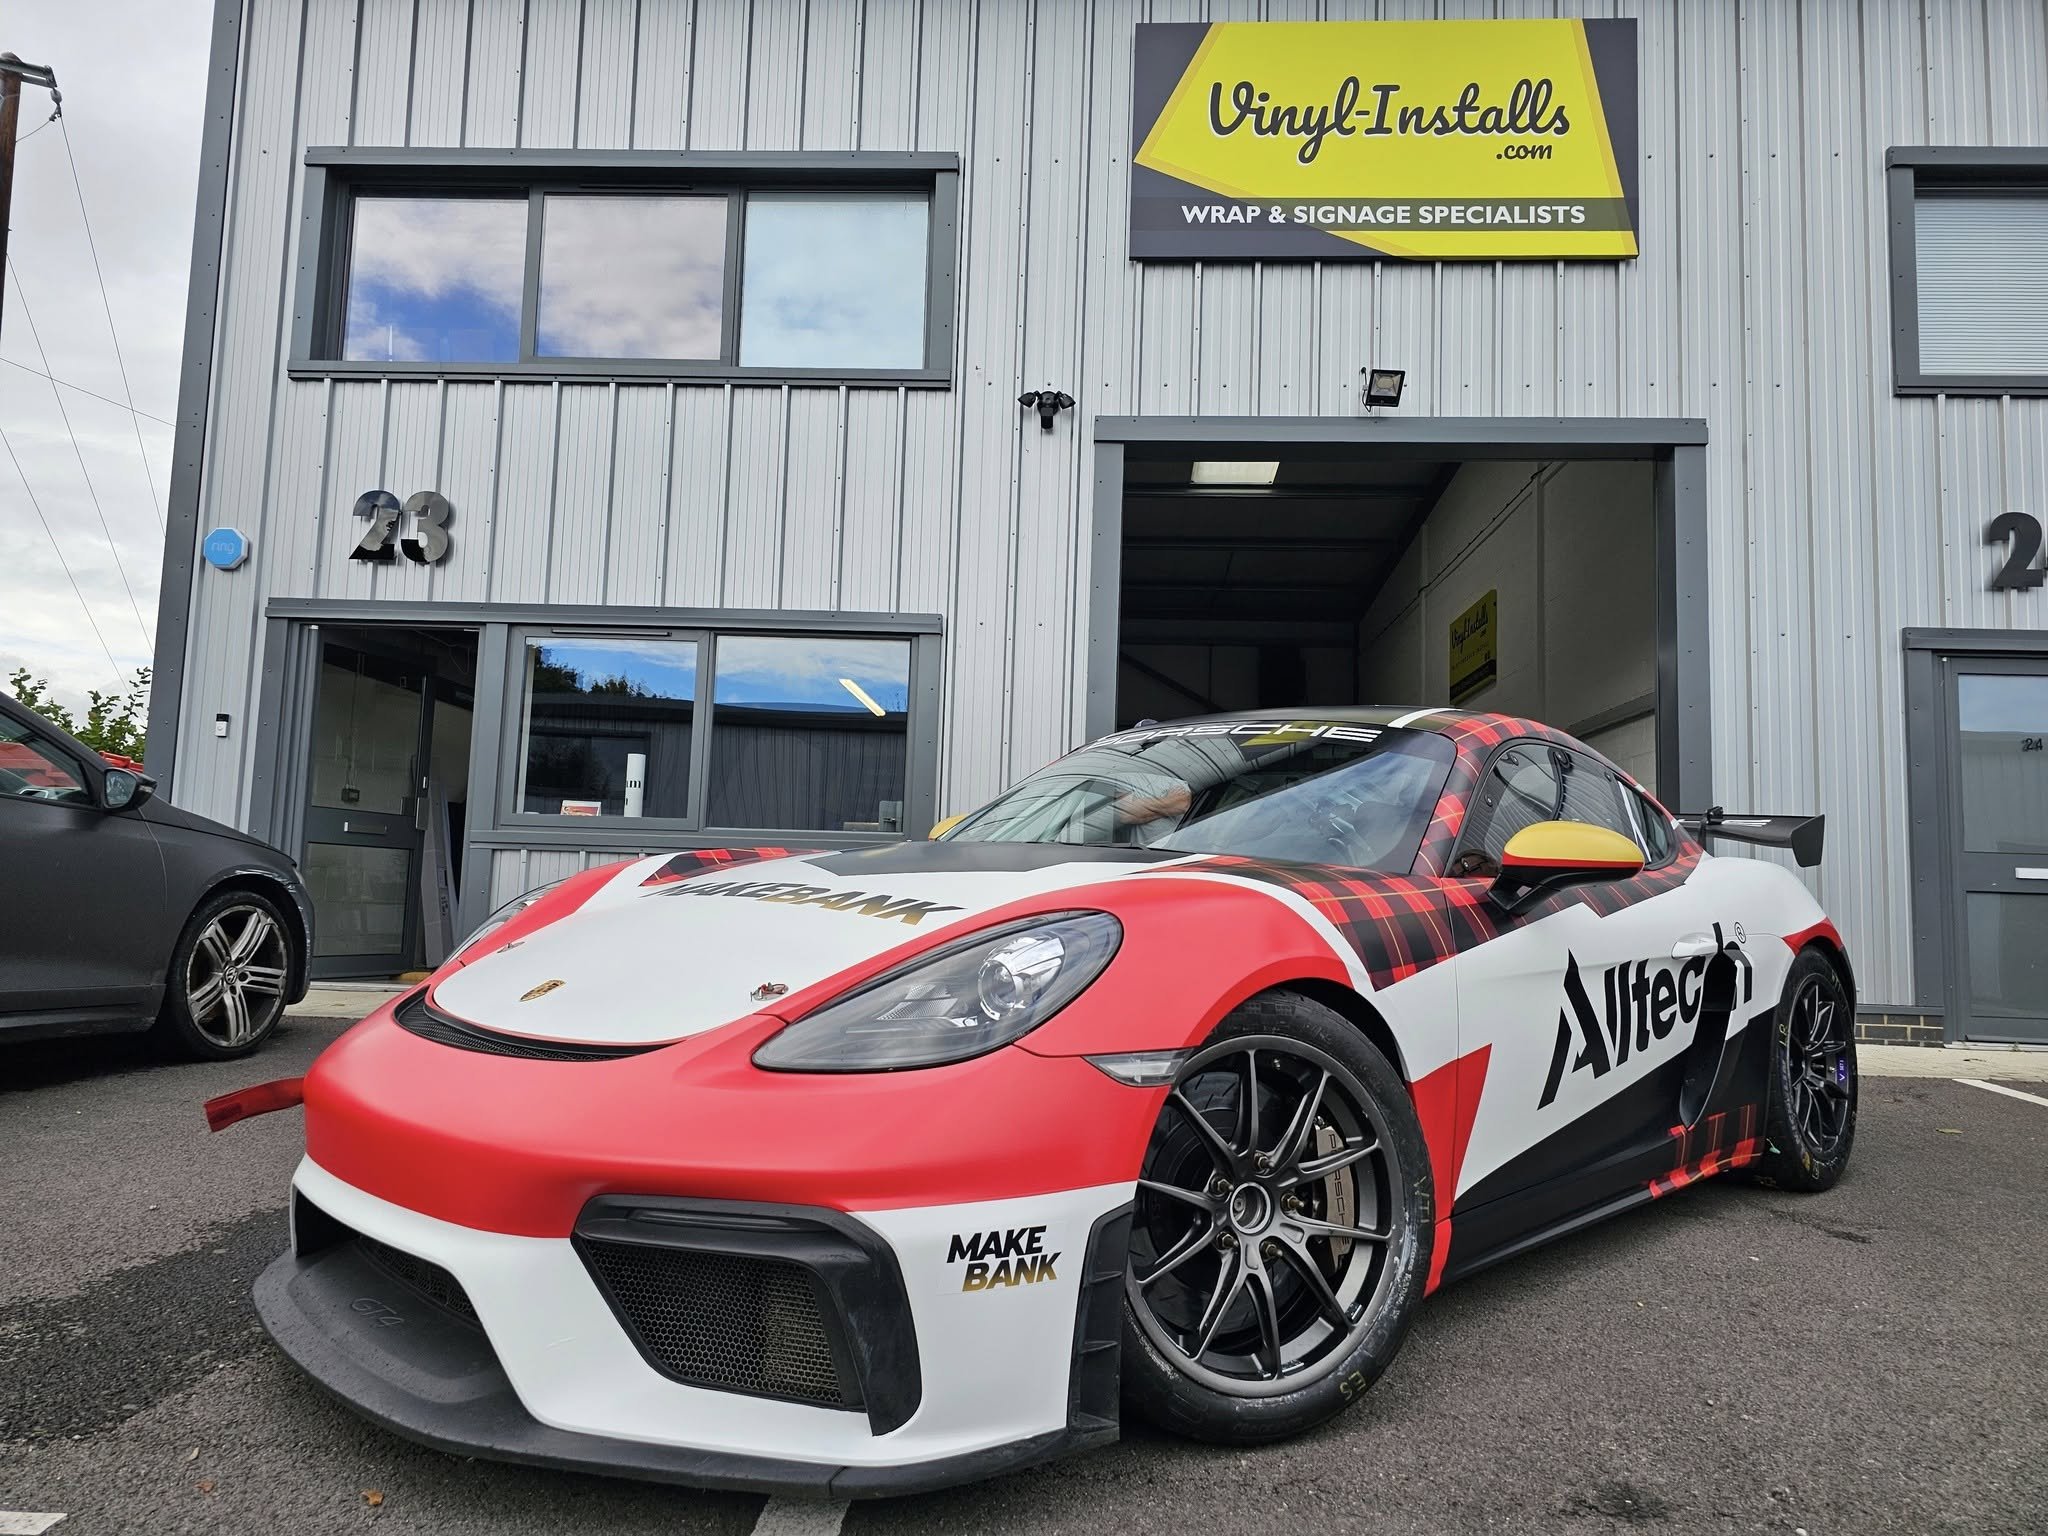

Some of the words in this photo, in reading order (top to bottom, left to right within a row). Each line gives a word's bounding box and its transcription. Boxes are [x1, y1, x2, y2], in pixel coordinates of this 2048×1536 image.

[1208, 75, 1571, 165] Vinyl-Installs
[1495, 143, 1553, 160] .com
[1181, 205, 1261, 224] WRAP
[1268, 205, 1287, 224] &
[1293, 204, 1411, 224] SIGNAGE
[1418, 204, 1586, 224] SPECIALISTS
[348, 489, 450, 564] 23
[1989, 511, 2048, 587] 2
[1079, 723, 1383, 753] PORSCHE
[2025, 737, 2043, 750] 24
[947, 1225, 1047, 1263] MAKE
[962, 1251, 1062, 1292] BANK
